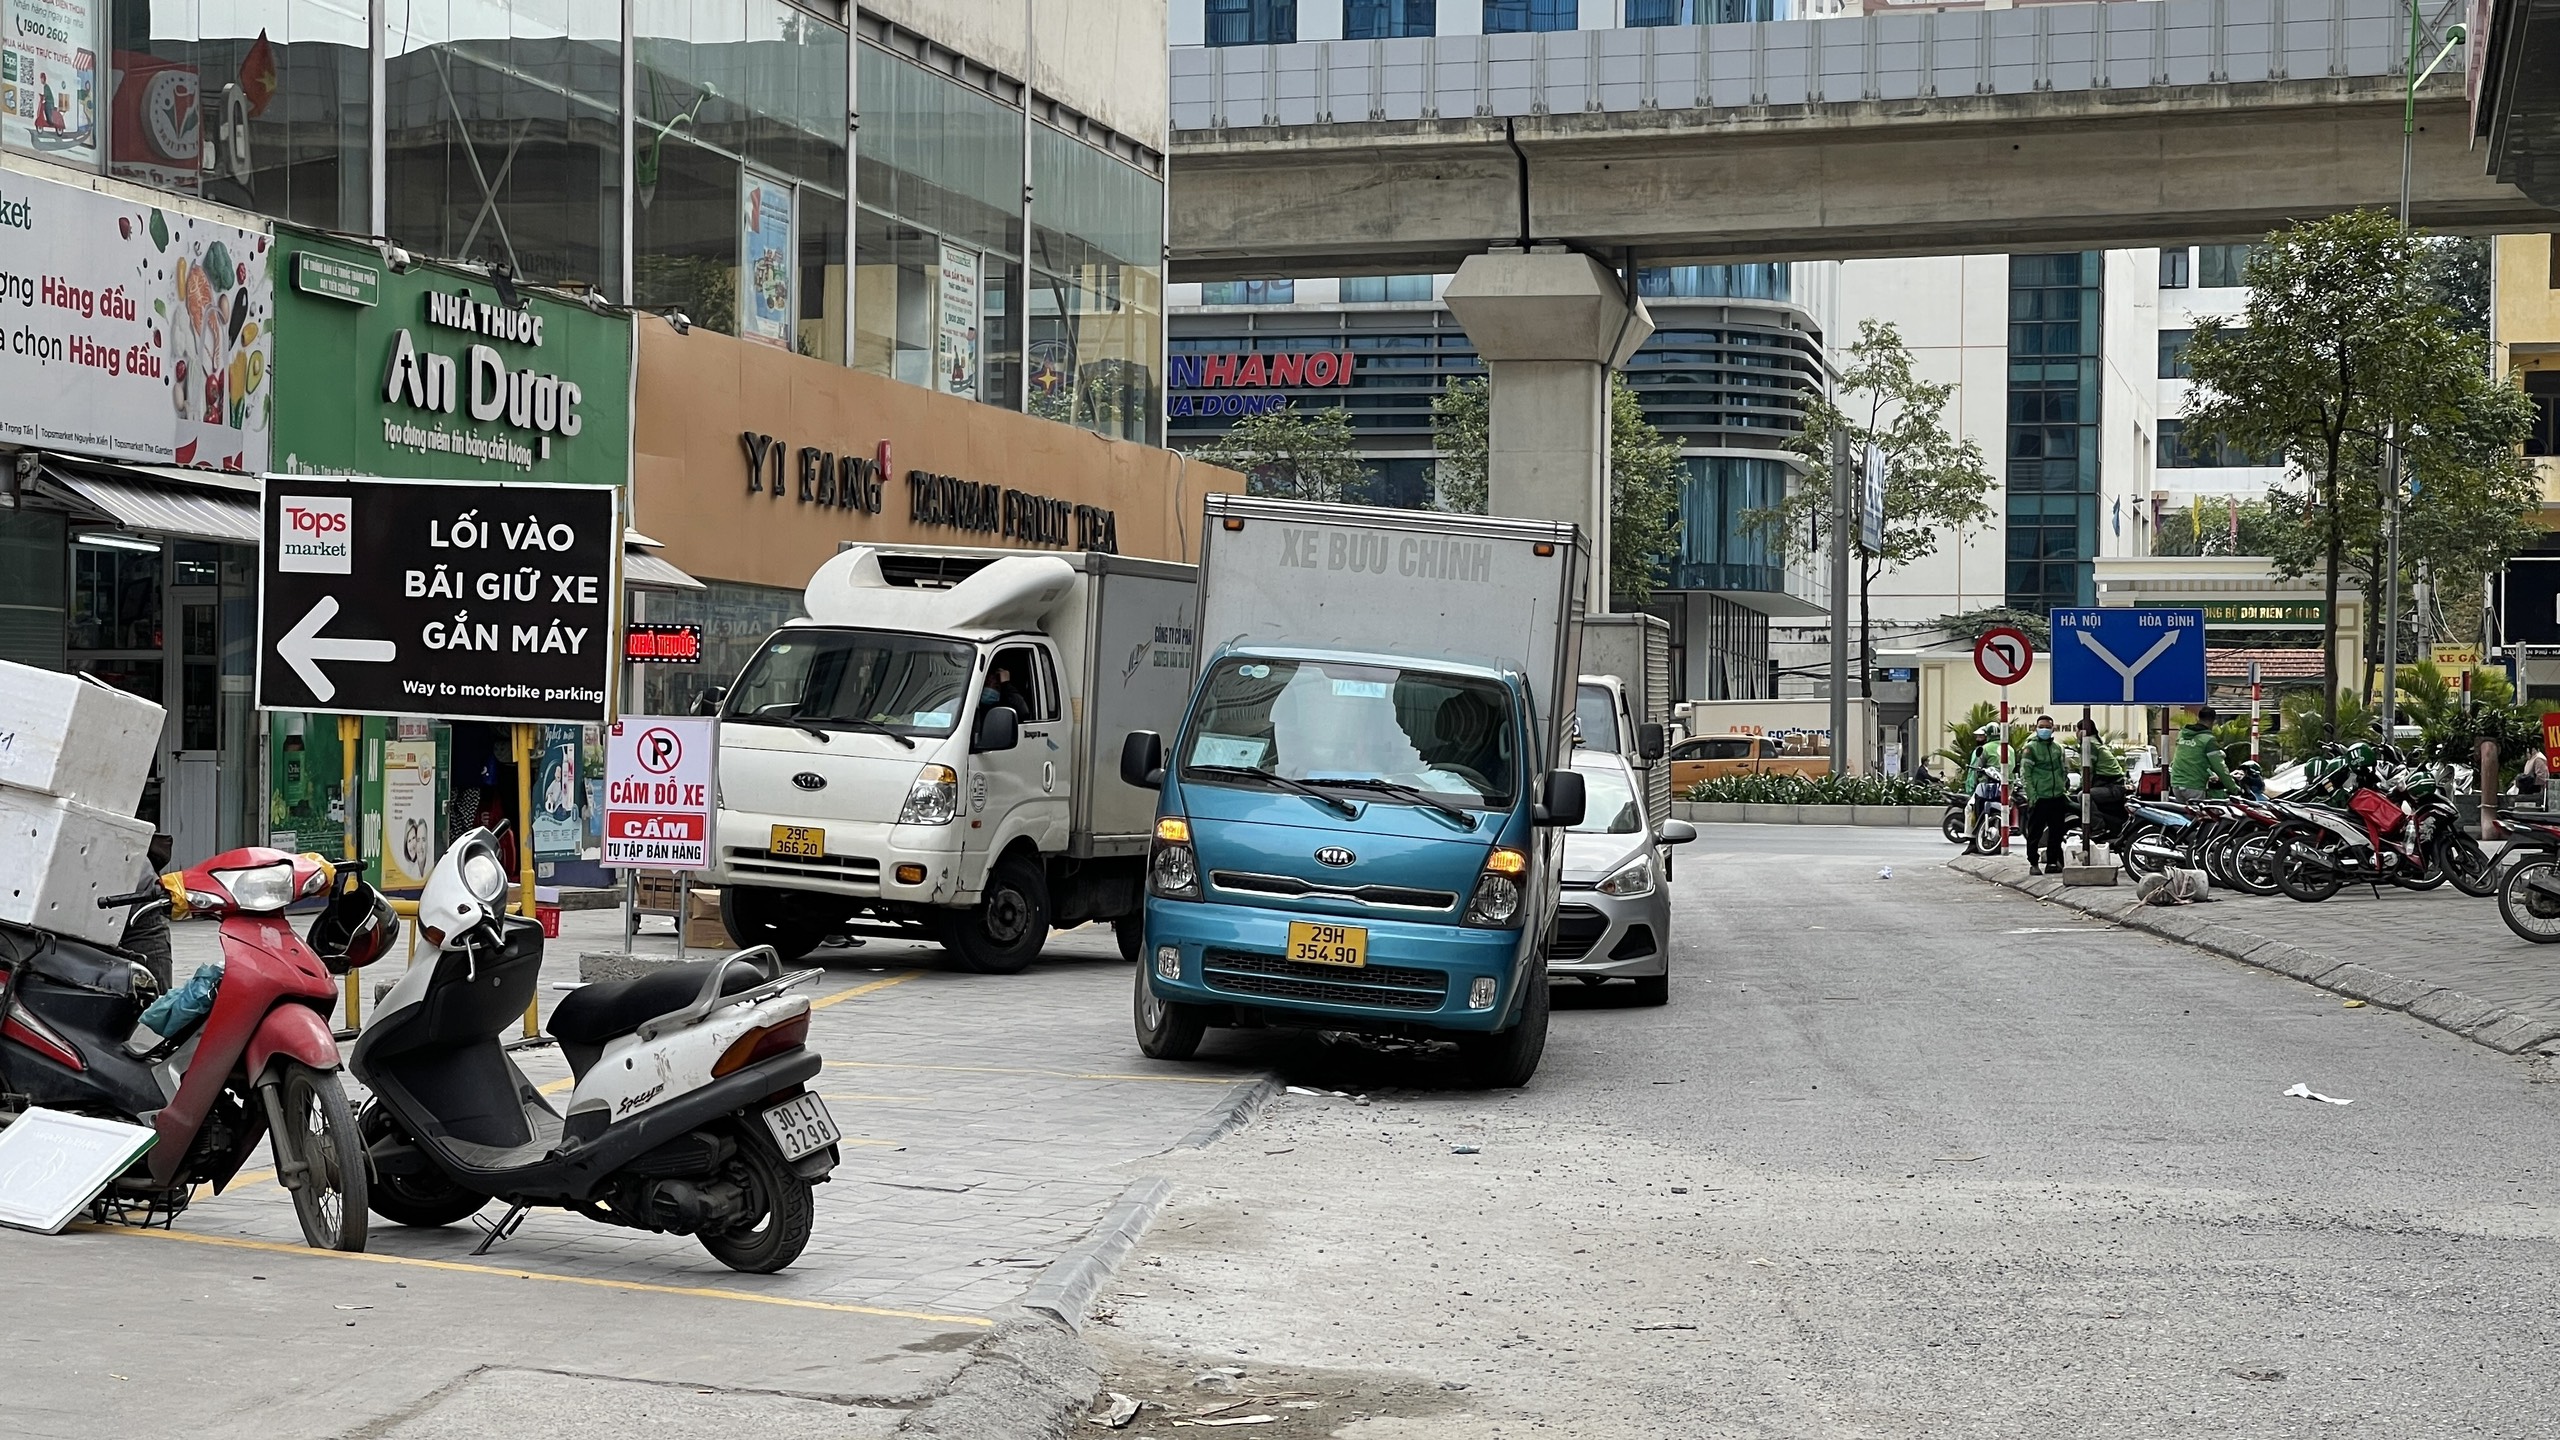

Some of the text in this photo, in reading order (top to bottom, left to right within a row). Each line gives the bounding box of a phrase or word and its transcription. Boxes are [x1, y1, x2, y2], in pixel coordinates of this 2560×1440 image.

[24, 19, 69, 44] 1900 2602
[41, 275, 94, 319] Hàng
[100, 284, 136, 322] đầu
[430, 288, 543, 347] NHÀ THUỐC
[12, 325, 62, 366] chọn
[69, 334, 119, 377] Hàng
[126, 341, 161, 379] đầu
[388, 328, 582, 459] An Dược
[384, 418, 532, 472] Tạo dựng niềm tin bằng chất lượng
[744, 431, 786, 497] YI
[801, 447, 882, 514] FANG
[285, 507, 347, 539] Tops
[431, 509, 575, 552] LỐI VÀO
[1005, 489, 1072, 546] FRUIT
[1075, 504, 1119, 555] TEA
[284, 541, 347, 557] market
[1279, 528, 1492, 582] XE BƯU CHÍNH
[405, 564, 599, 604] BÃI GIỮ XE
[422, 609, 589, 655] GẮN MÁY
[2060, 612, 2101, 628] HÀ NỘI
[2139, 612, 2195, 627] HÒA BÌNH
[630, 628, 696, 656] NHÀ THUỐC
[1169, 627, 1174, 644] TY
[2436, 654, 2478, 663] XE GA
[403, 680, 604, 703] Way to motorbike parking
[610, 774, 705, 807] CẤM ĐỖ XE
[798, 775, 821, 787] KIA
[624, 816, 688, 839] CẤM
[786, 828, 809, 841] 29C
[608, 841, 701, 860] TỤ TẬP BÁN HÀNG
[776, 840, 818, 856] 366.20
[1321, 849, 1349, 863] KIA
[1311, 926, 1345, 944] 29H
[1296, 943, 1357, 964] 354.90
[773, 1096, 820, 1131] 30-L1
[785, 1120, 832, 1154] 3298
